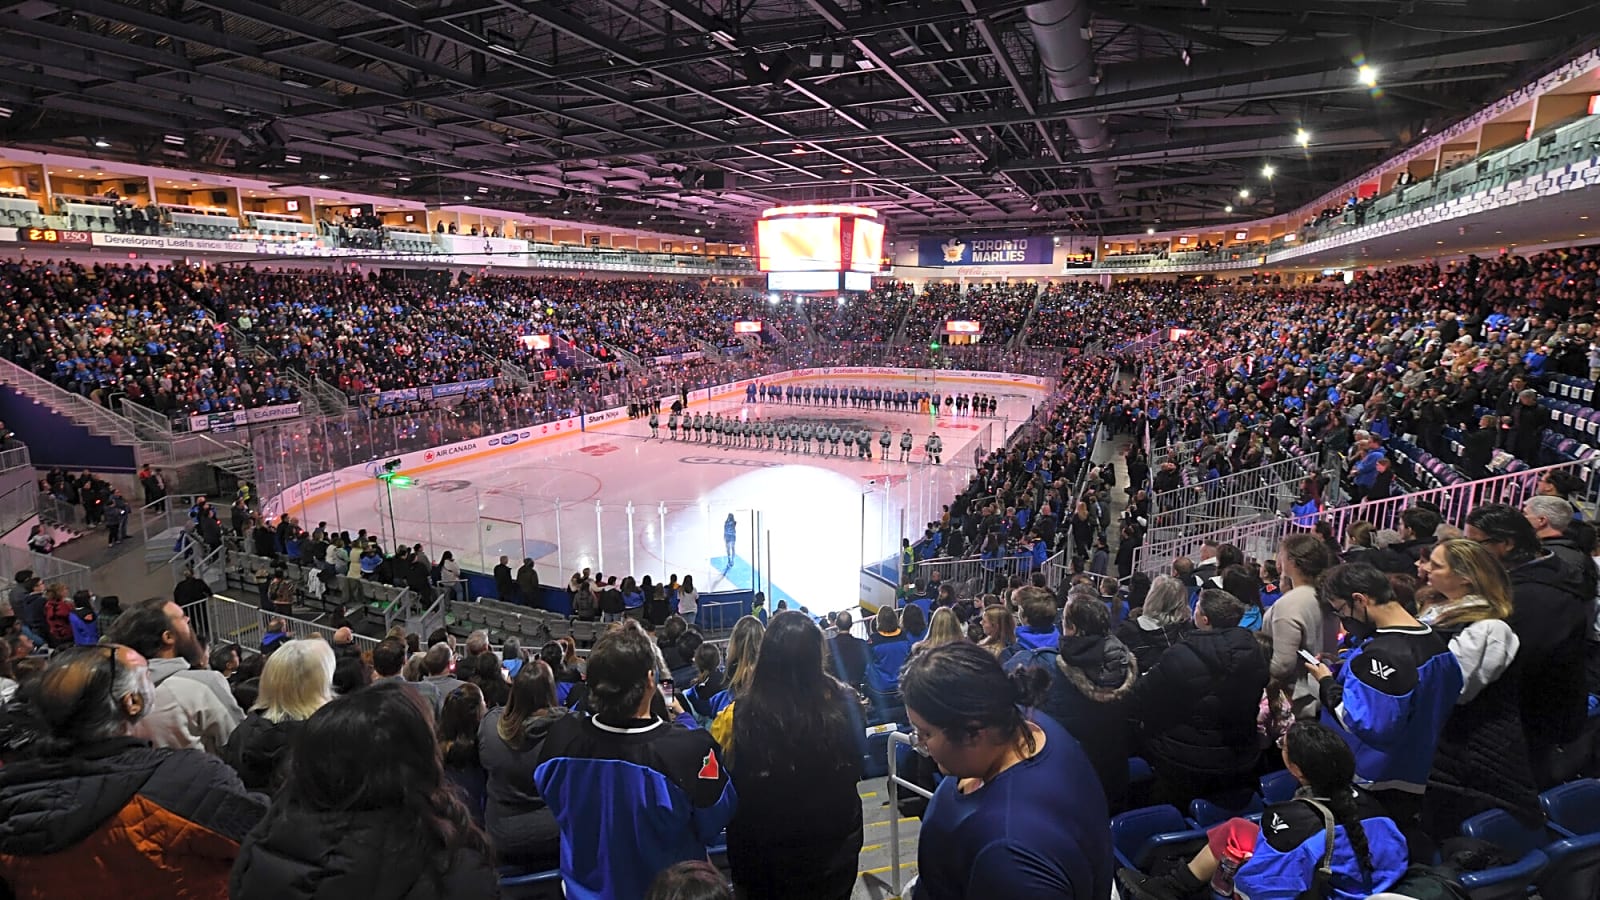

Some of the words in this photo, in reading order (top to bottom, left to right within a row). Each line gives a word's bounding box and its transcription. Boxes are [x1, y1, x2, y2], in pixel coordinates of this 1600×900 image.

[104, 235, 164, 247] Developing
[167, 239, 193, 248] Leafs
[196, 241, 220, 249] since
[971, 239, 1028, 251] TORONTO
[972, 250, 1025, 262] MARLIES
[254, 406, 300, 418] EARNED
[436, 449, 449, 458] AIR
[448, 443, 477, 455] CANADA
